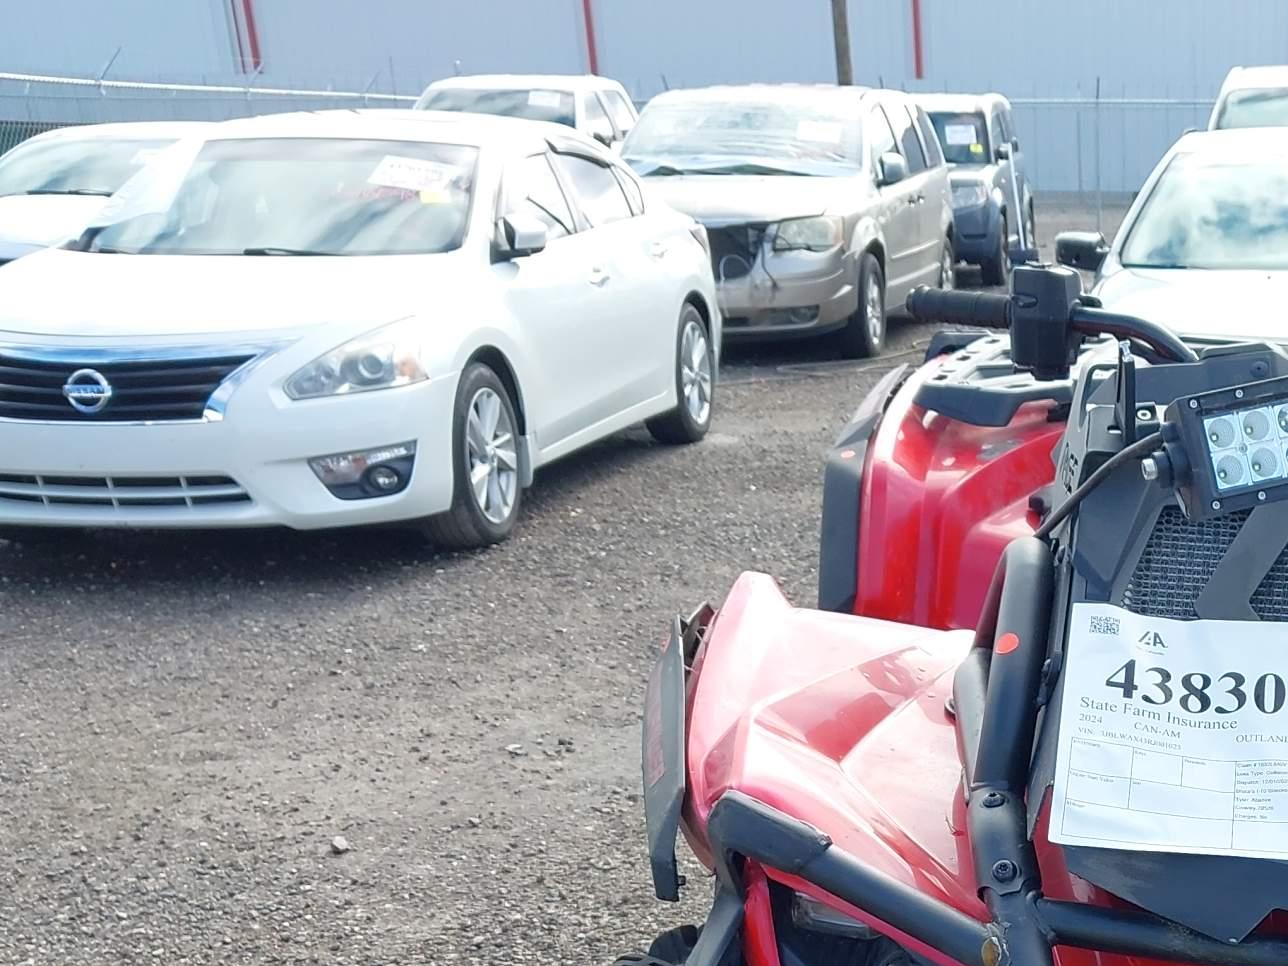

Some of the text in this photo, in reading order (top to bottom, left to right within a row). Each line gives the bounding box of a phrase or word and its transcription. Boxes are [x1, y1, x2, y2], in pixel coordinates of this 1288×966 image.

[1079, 696, 1238, 730] State Farm Insurance
[1079, 713, 1103, 724] 2024
[1134, 722, 1182, 739] CAN-AM
